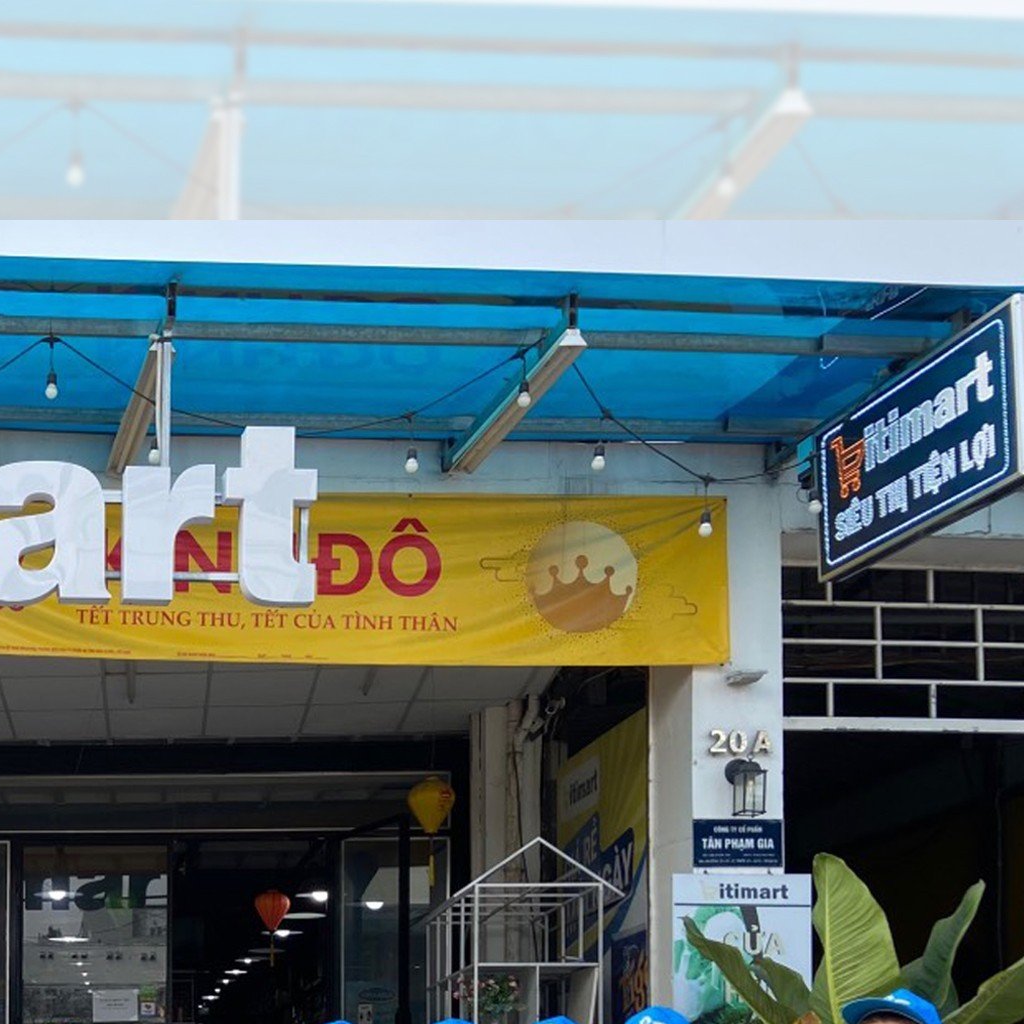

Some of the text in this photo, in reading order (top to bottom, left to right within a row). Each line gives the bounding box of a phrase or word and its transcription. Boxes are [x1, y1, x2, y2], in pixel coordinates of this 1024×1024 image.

[310, 517, 443, 598] ĐÔ
[76, 605, 458, 632] TẾT TRUNG THU, TẾT CỦA TÌNH THÂN
[702, 836, 775, 851] TÂN PHẠM GIA
